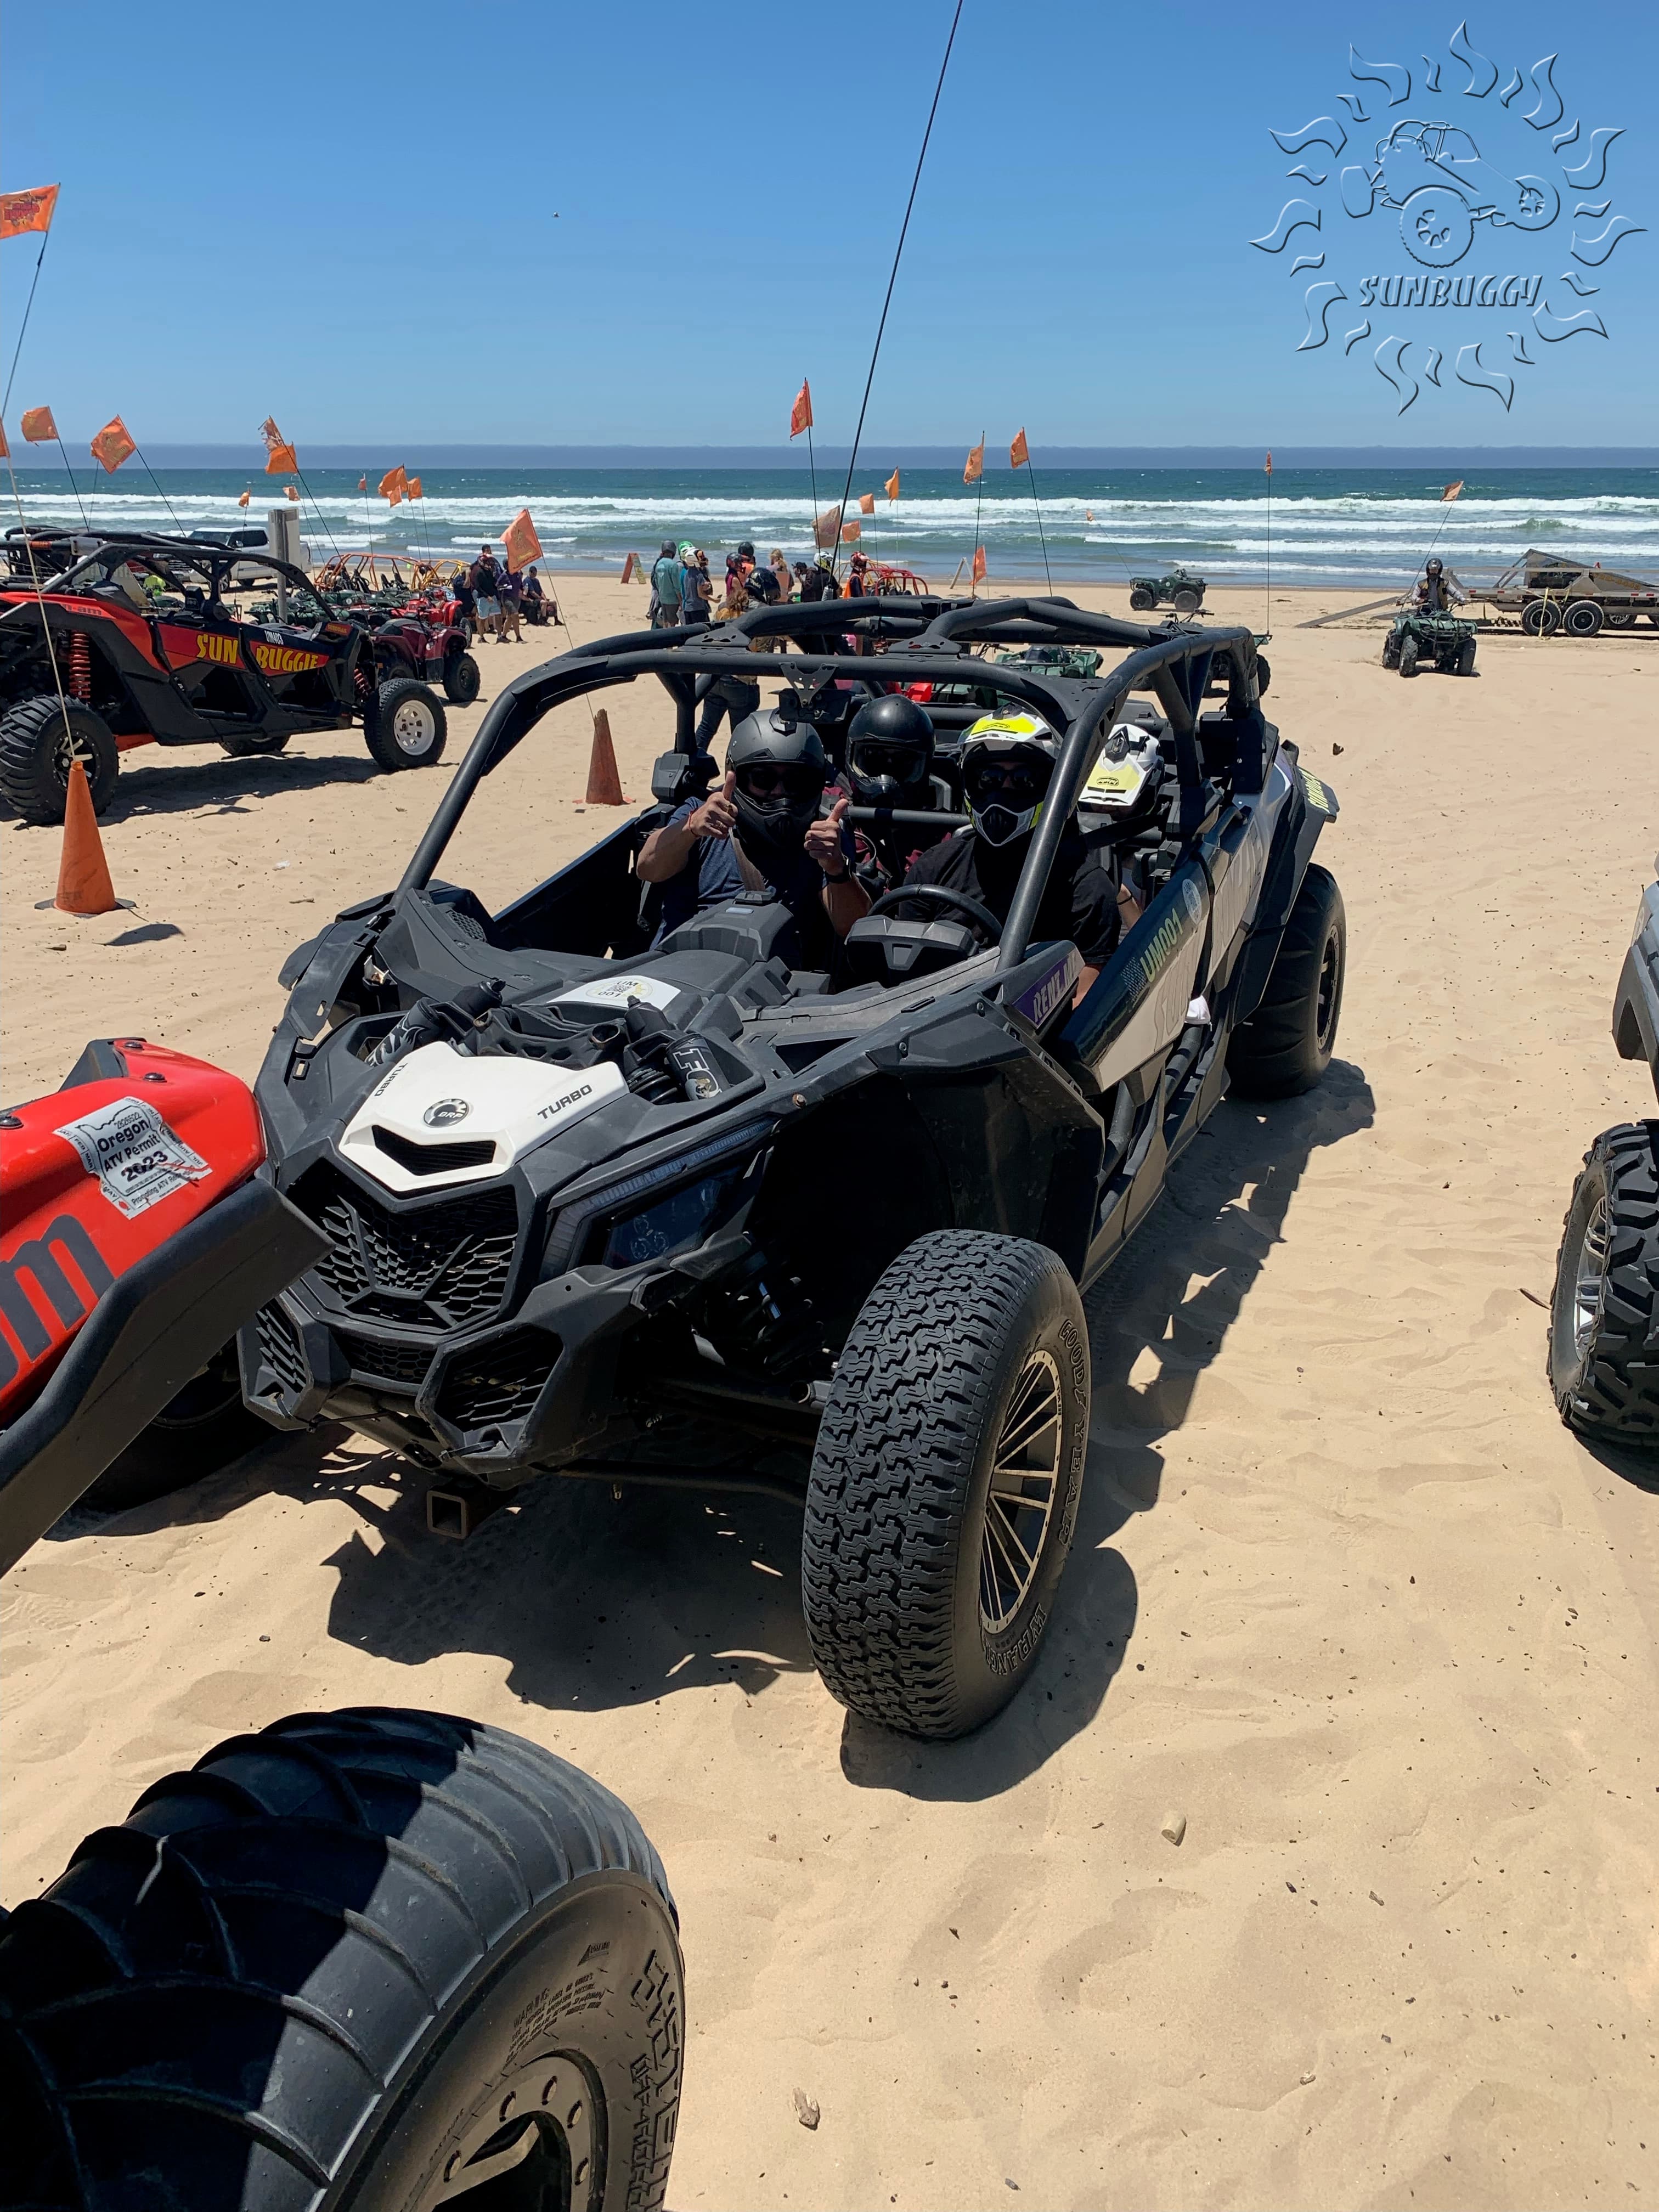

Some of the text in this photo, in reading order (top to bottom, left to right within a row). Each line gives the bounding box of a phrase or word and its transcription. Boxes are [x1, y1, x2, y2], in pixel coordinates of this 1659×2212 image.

[196, 634, 239, 664] SUN
[1139, 908, 1183, 983] UM001
[1033, 969, 1061, 1023] RENT
[374, 1063, 408, 1097] TURBO
[673, 1048, 722, 1099] FO
[537, 1084, 592, 1120] TURBO
[97, 1119, 150, 1152] Oregon
[103, 1151, 123, 1172] ATV
[124, 1133, 161, 1160] Permit
[121, 1150, 168, 1182] 2023
[1058, 1318, 1087, 1546] GOODYEAR
